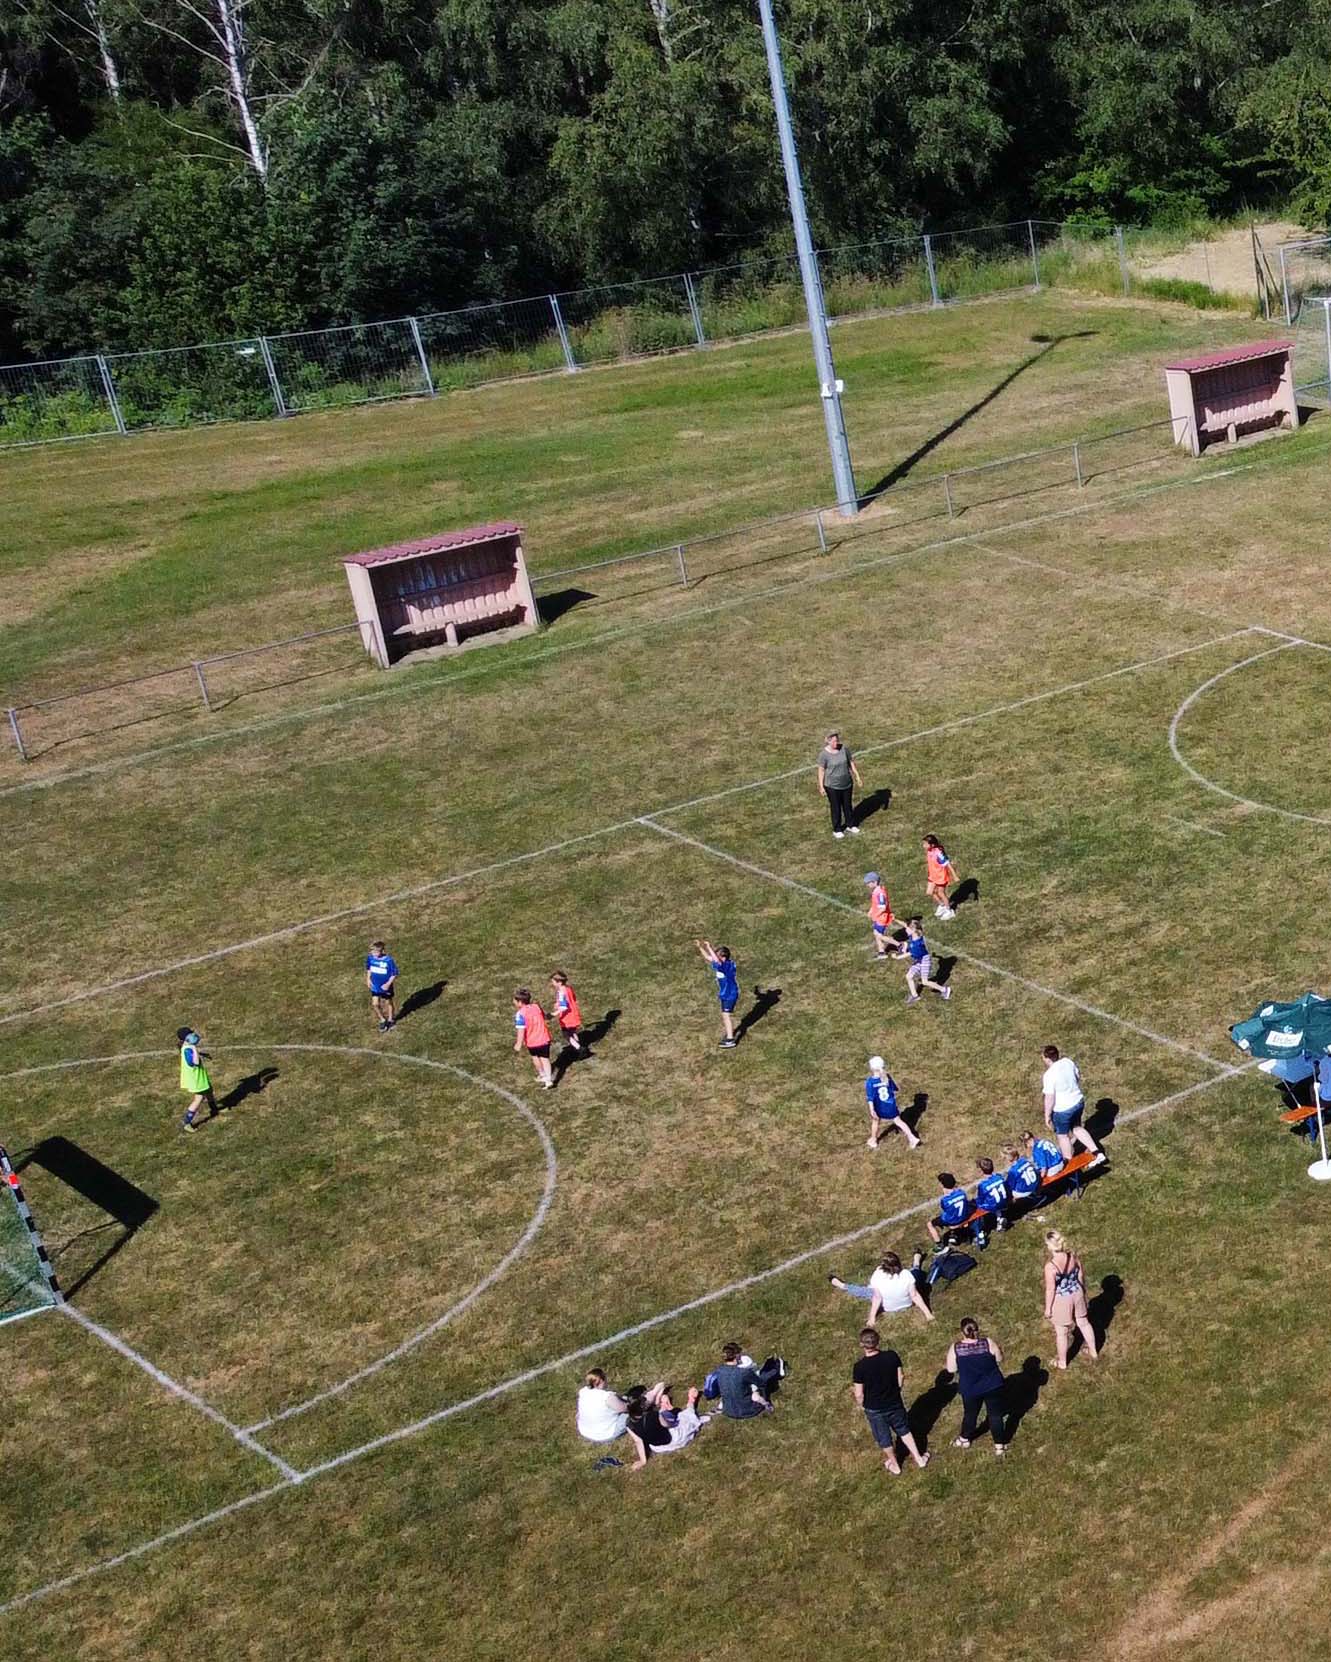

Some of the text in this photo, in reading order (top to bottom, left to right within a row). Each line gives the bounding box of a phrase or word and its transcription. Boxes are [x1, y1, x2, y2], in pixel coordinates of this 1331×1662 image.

[878, 1086, 889, 1101] 8
[1021, 1167, 1037, 1186] 16
[989, 1183, 1007, 1203] 11
[953, 1199, 964, 1217] 7
